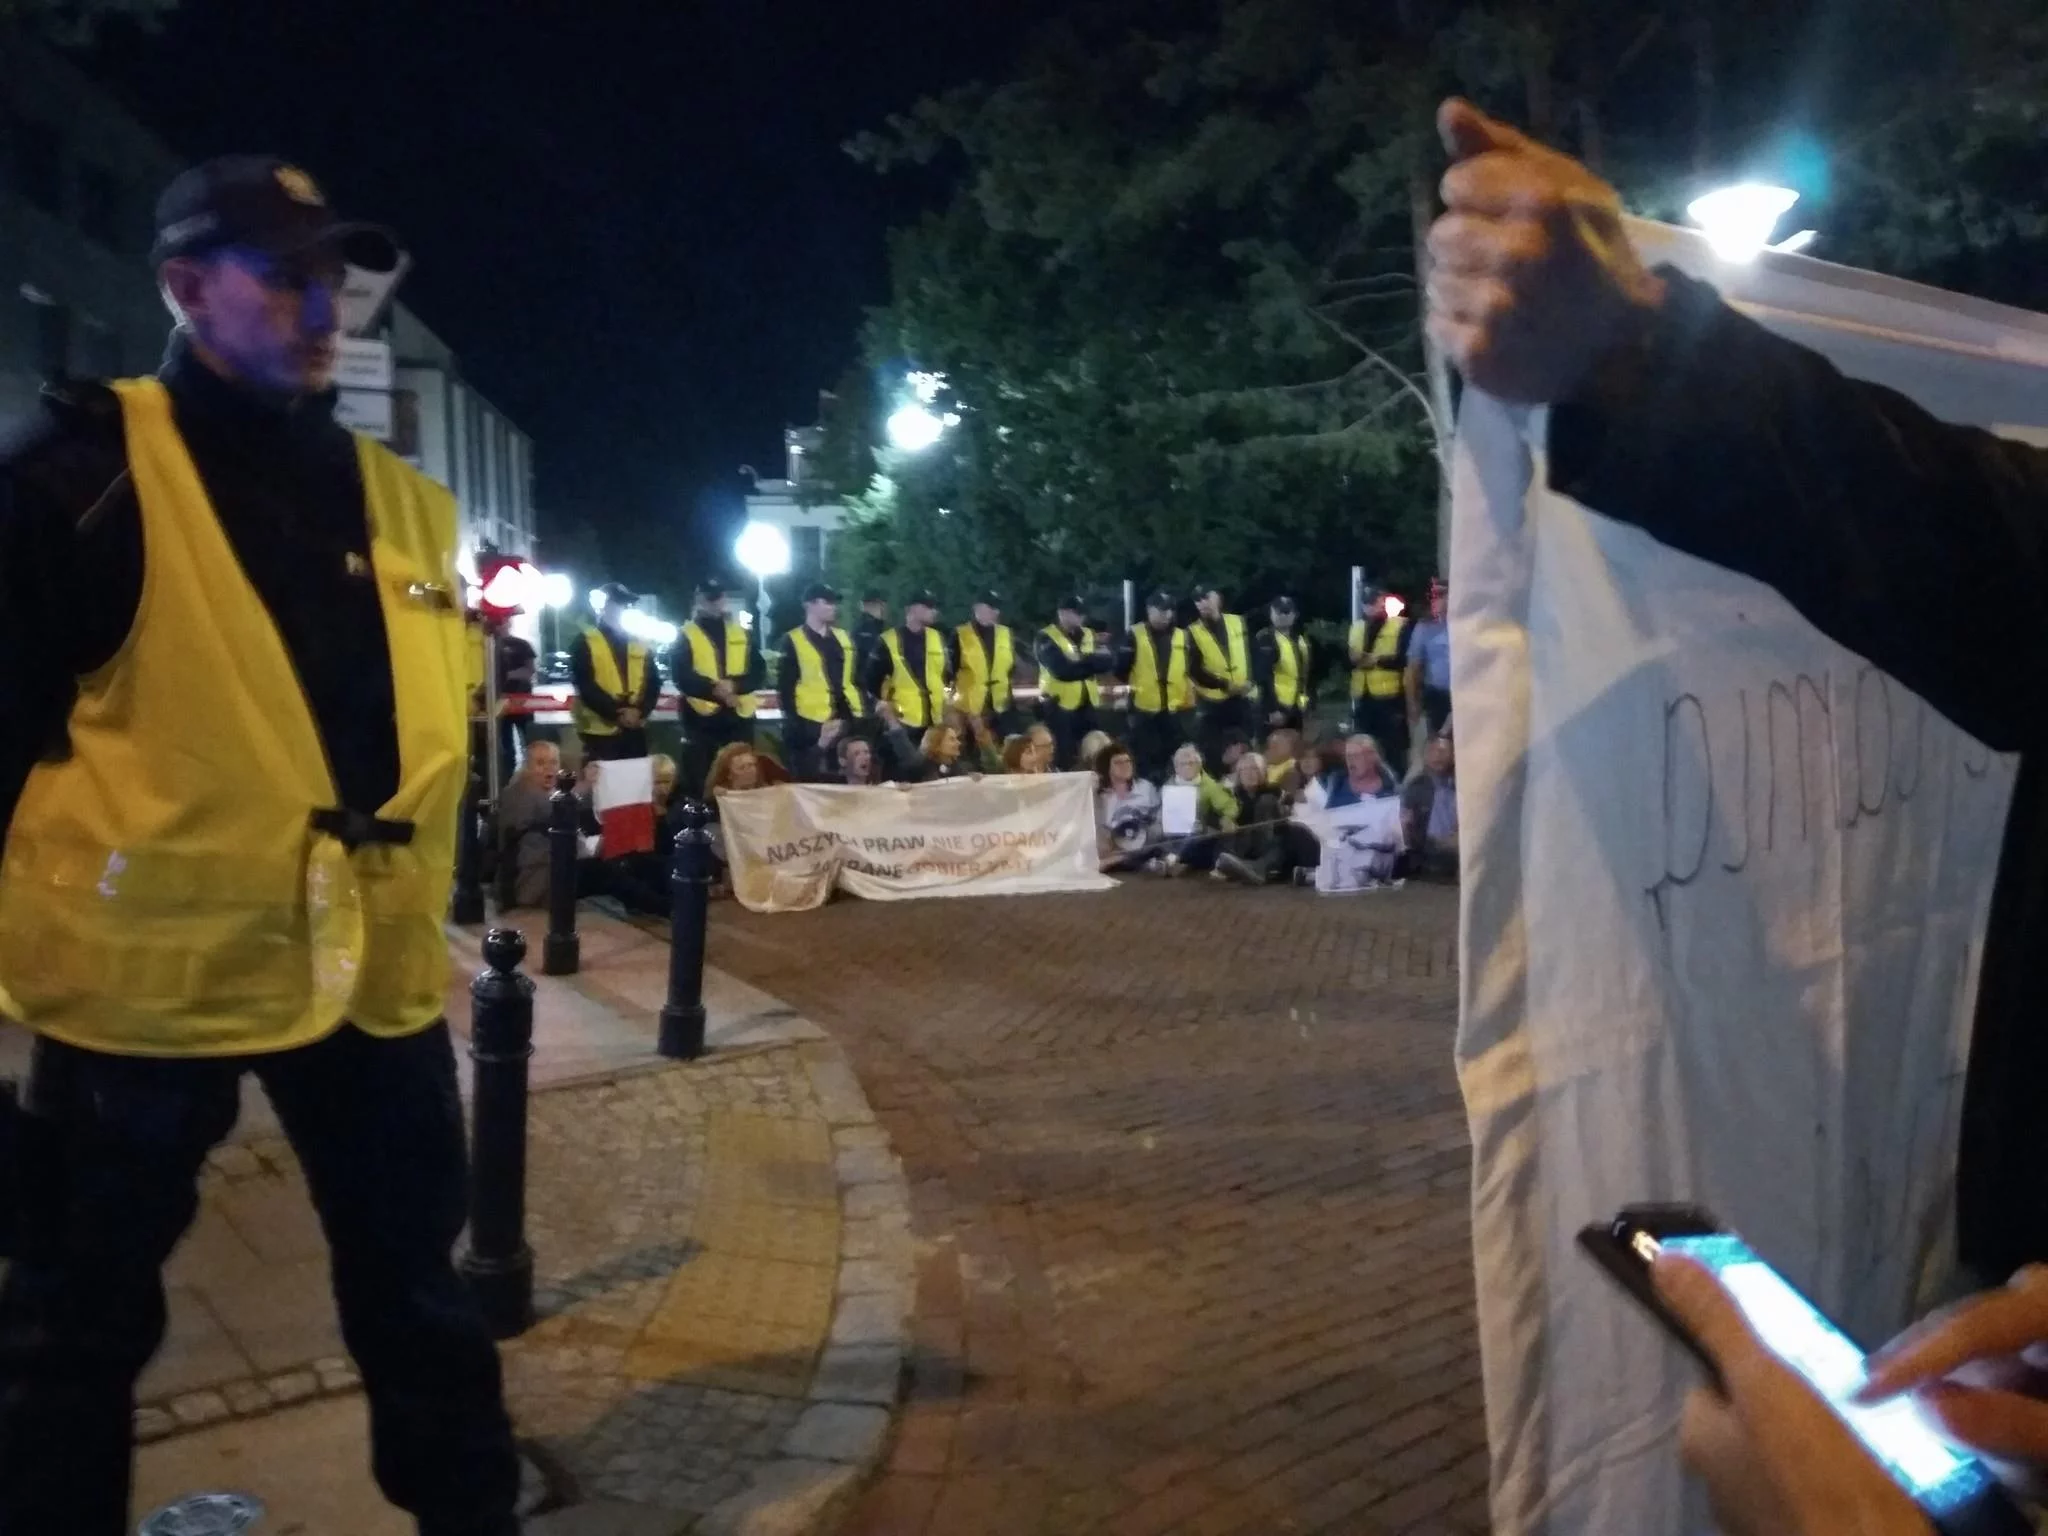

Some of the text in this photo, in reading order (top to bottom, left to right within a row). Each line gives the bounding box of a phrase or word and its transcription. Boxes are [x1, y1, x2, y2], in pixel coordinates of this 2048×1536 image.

[865, 834, 926, 851] PRAW
[932, 835, 964, 850] NIE
[970, 830, 1059, 849] ODDAMY
